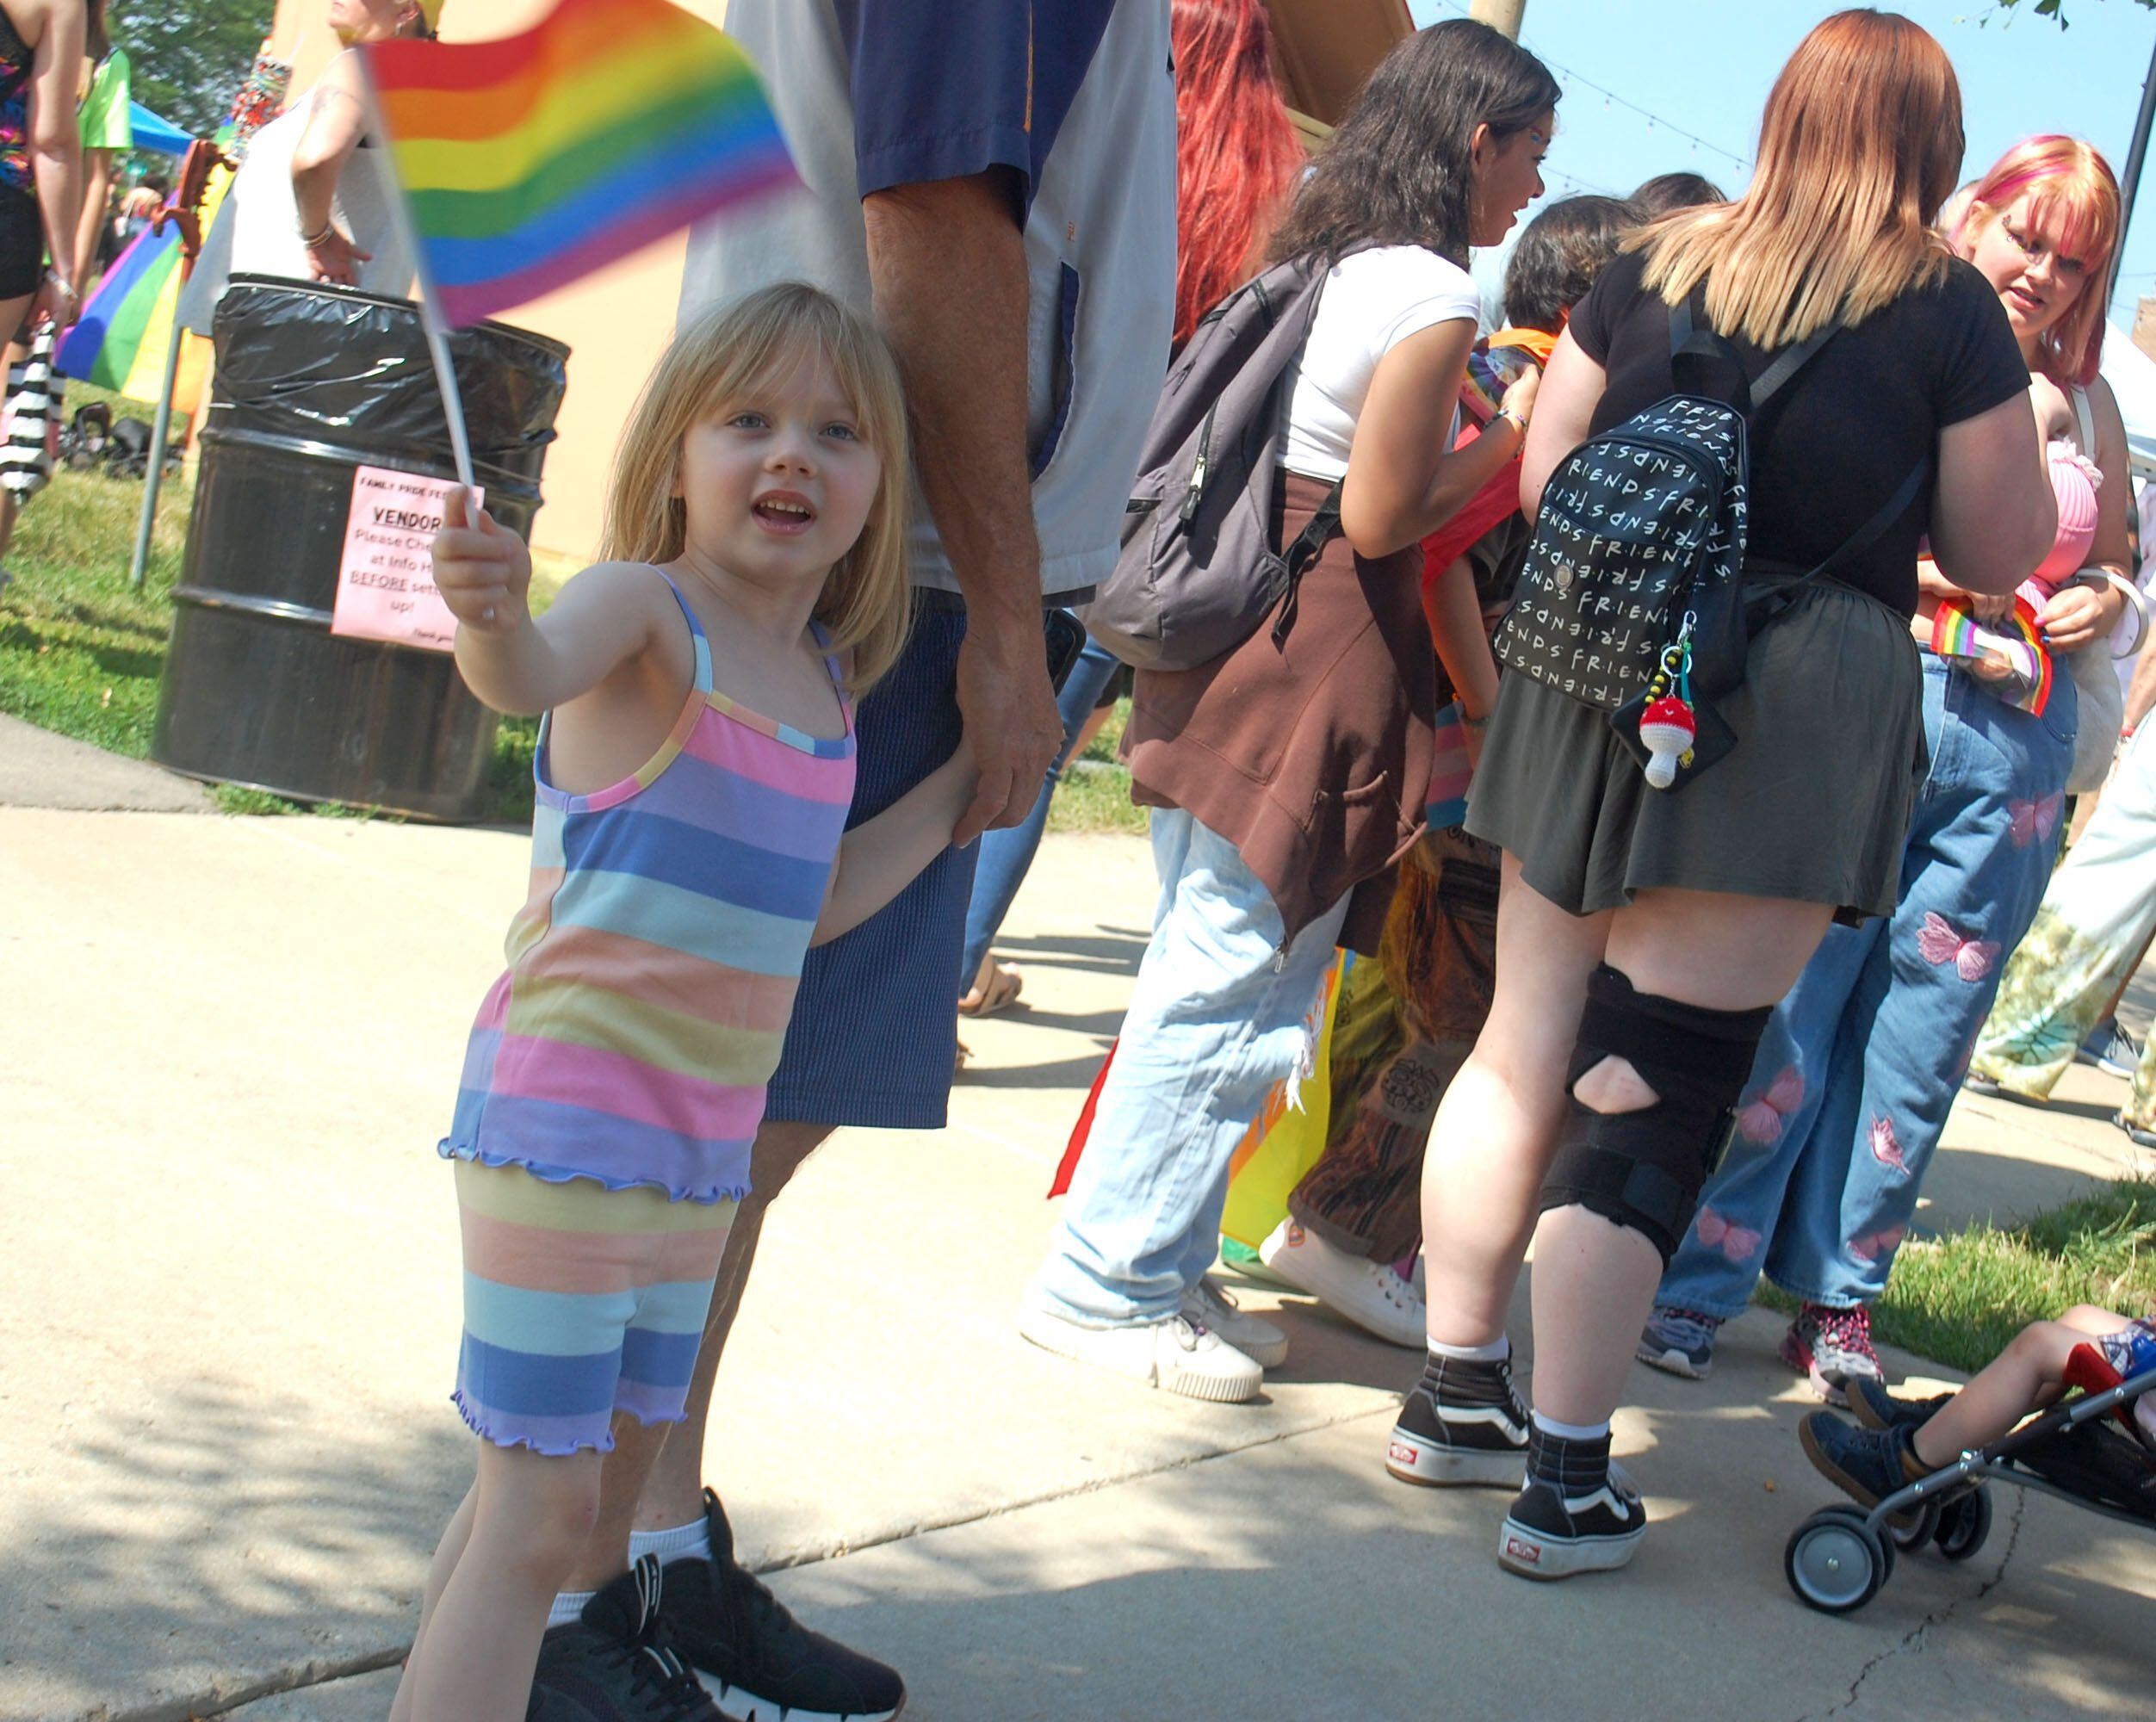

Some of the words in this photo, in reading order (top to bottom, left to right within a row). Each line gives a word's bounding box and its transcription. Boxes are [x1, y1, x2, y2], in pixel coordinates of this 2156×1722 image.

[356, 529, 402, 548] Please
[370, 554, 384, 566] at
[350, 570, 408, 592] BEFORE
